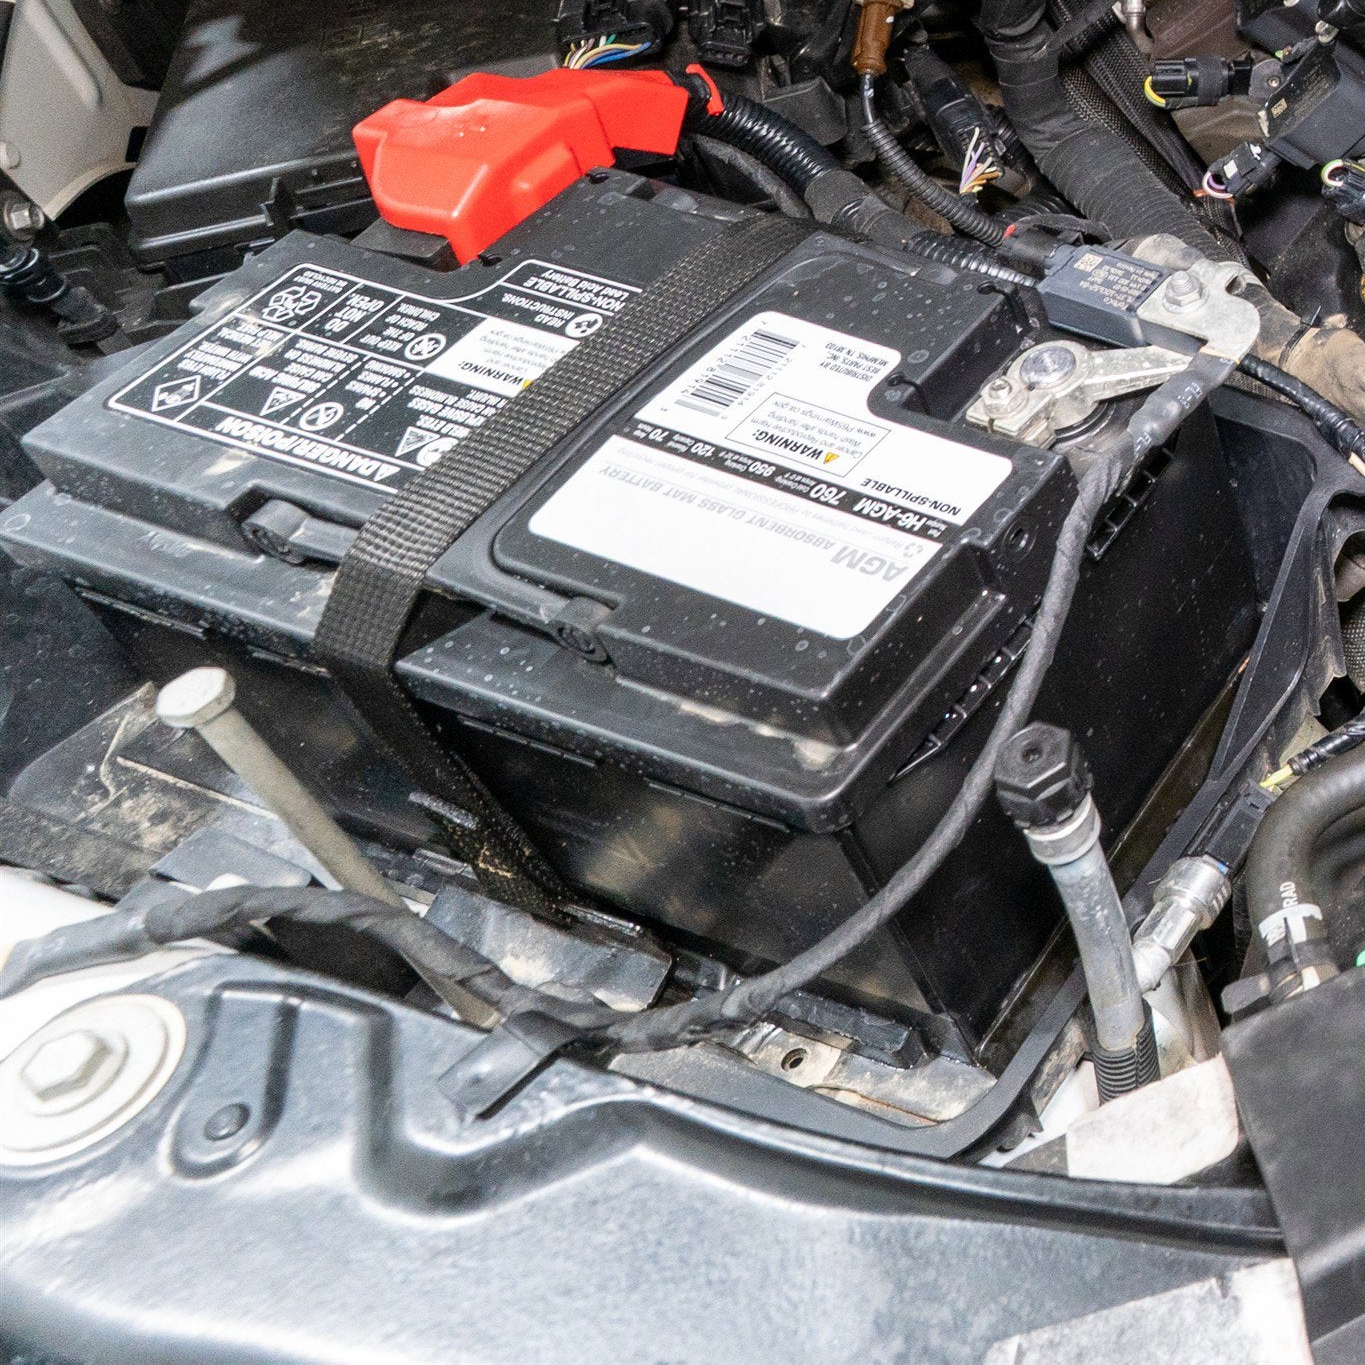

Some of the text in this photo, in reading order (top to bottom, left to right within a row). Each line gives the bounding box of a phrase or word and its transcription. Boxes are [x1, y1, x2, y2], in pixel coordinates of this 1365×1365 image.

[521, 275, 627, 312] NON-SPILLABLE
[538, 268, 631, 300] Lead Acid Battery
[341, 292, 387, 312] OPEN.
[496, 292, 576, 320] INSTRUCTIONS.
[332, 305, 369, 322] NOT
[383, 313, 429, 331] REACH OF
[531, 312, 567, 327] READ
[321, 317, 351, 332] DO
[380, 325, 417, 341] OF THE
[357, 333, 404, 351] KEEP OUT
[842, 348, 857, 356] TN
[454, 359, 526, 385] WARNING:
[817, 360, 874, 381] DISTRIBUTED BY
[861, 364, 881, 374] BEST
[405, 384, 460, 405] BLINDNESS
[404, 396, 445, 414] GASES
[451, 397, 487, 413] CAUSE
[645, 427, 670, 441] 70
[748, 428, 826, 459] WARNING:
[210, 415, 386, 476] DANGER/POISON
[687, 441, 718, 457] 120
[832, 444, 864, 459] Cancer
[745, 460, 777, 477] 950
[806, 482, 848, 505] 760
[858, 477, 962, 516] NON-SPILLABLE
[851, 496, 928, 531] H6-AGM
[596, 464, 909, 583] AGM ABSORBENT GLASS MAT BATTERY
[1280, 881, 1298, 908] RAD
